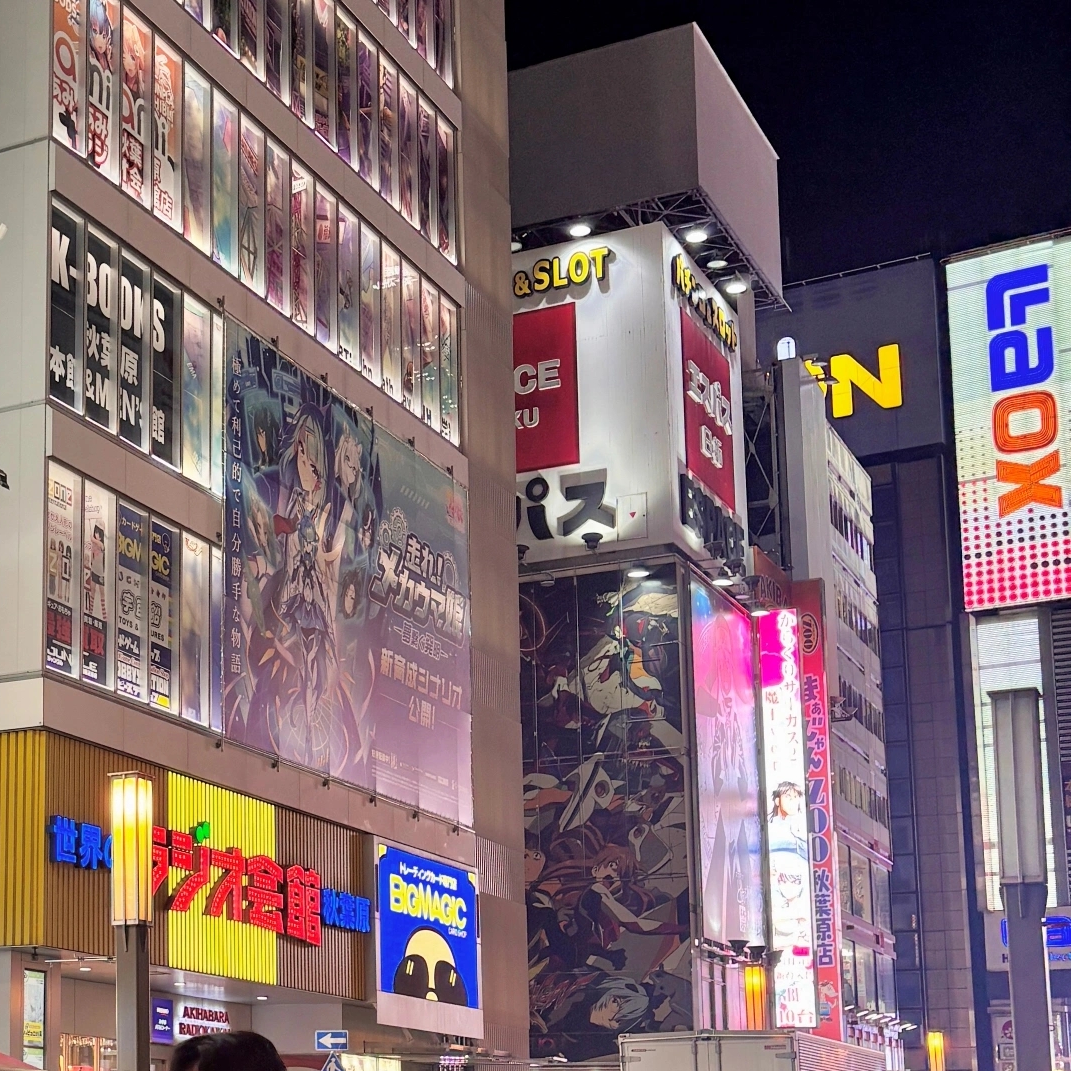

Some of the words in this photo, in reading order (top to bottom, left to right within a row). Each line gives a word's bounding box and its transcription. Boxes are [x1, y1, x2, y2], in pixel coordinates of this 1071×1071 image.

[231, 358, 242, 674] 極めて利己的で自分勝手な物語
[119, 616, 133, 629] TOYS
[381, 648, 462, 710] 新育成シナリオ
[408, 696, 435, 730] 公開!
[321, 888, 371, 934] 秋葉原
[390, 874, 467, 929] BIGMAGIC
[183, 1006, 229, 1023] AKIHABARA
